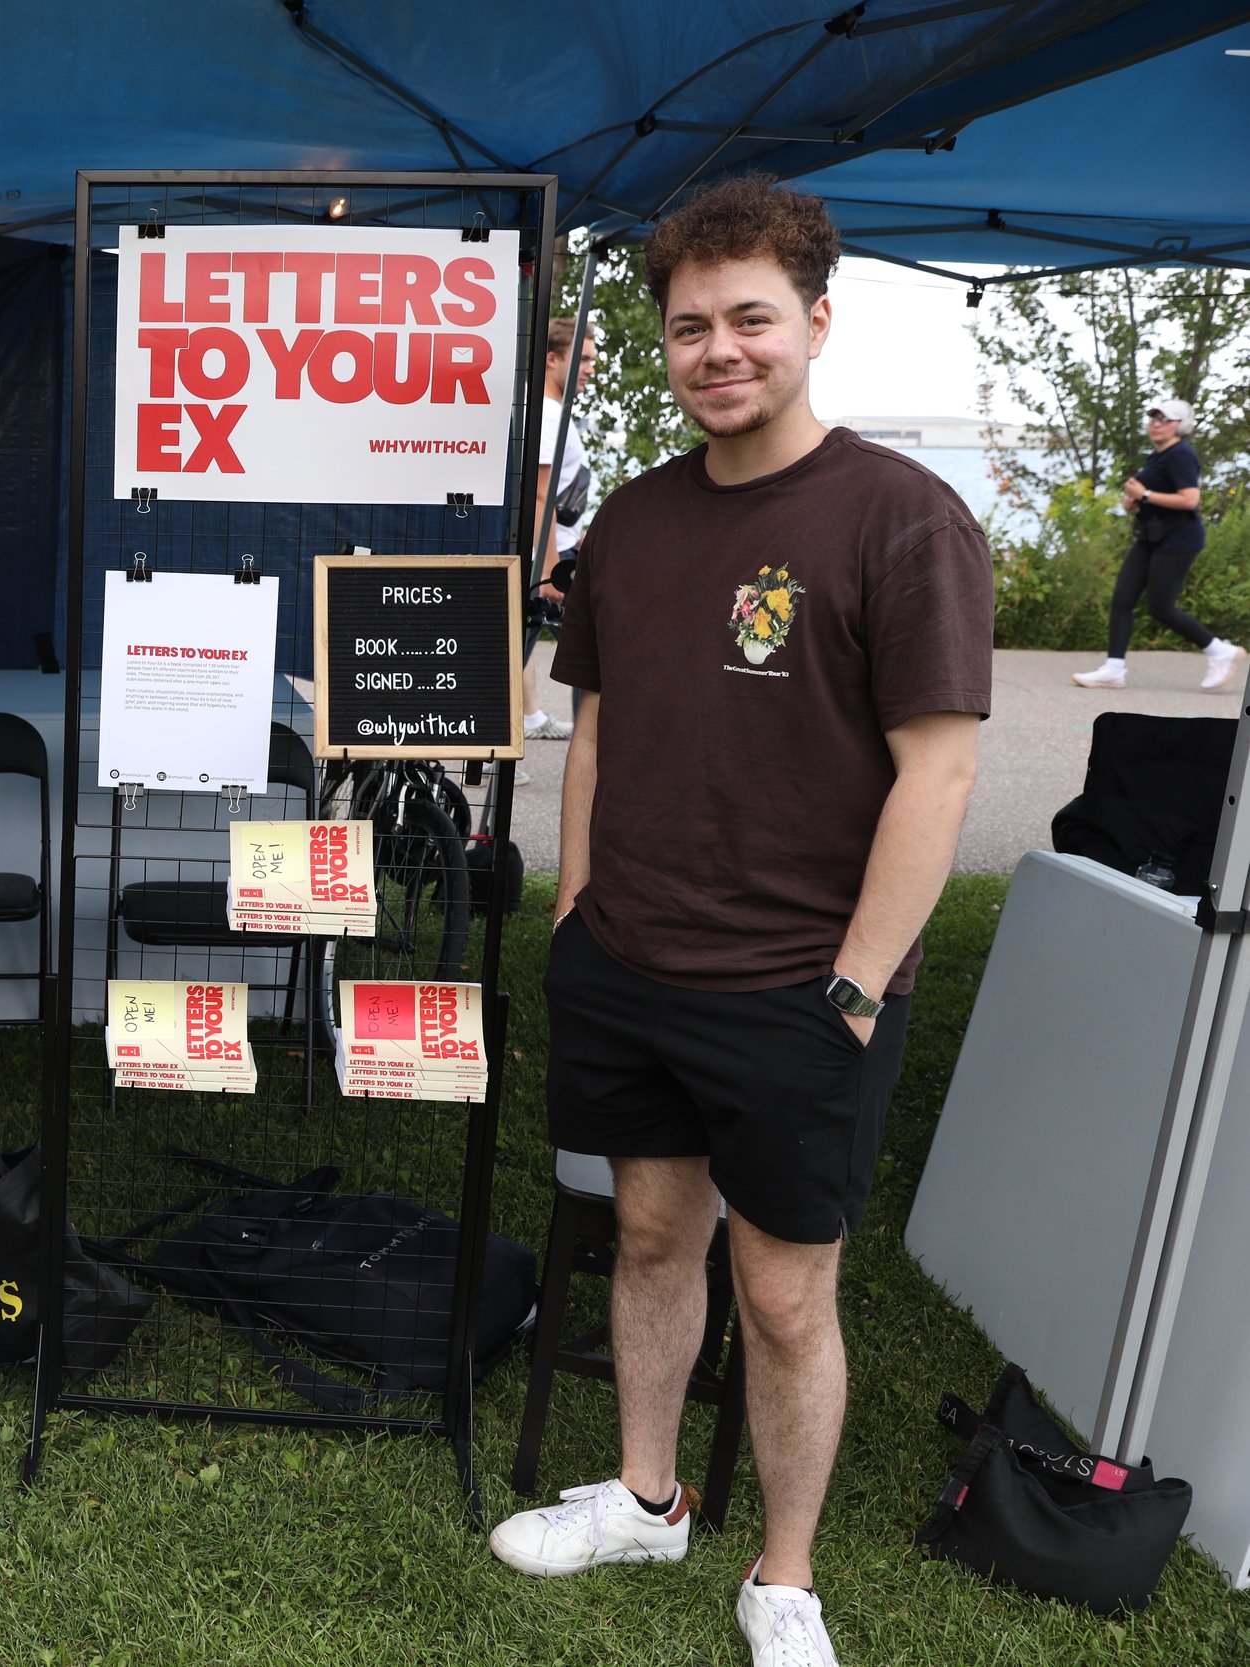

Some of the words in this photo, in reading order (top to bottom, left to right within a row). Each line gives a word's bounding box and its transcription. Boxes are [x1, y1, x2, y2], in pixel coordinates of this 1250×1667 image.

[139, 252, 497, 327] LETTERS
[137, 327, 251, 400] TO
[256, 329, 493, 405] YOUR
[136, 403, 248, 474] EX
[369, 439, 487, 455] WHYWITHCAI
[127, 645, 178, 657] LETTERS
[180, 648, 196, 658] TO
[197, 648, 231, 660] YOUR
[232, 650, 248, 660] EX
[357, 713, 476, 746] @whywithcai
[250, 843, 266, 880] OPEN
[310, 825, 330, 901] LETTERS
[329, 825, 349, 881] YOUR
[275, 902, 292, 910] YOUR
[330, 882, 349, 902] TO
[349, 884, 369, 903] EX
[125, 995, 137, 1033] OPEN
[186, 985, 205, 1060] LETTERS
[205, 986, 223, 1038] YOUR
[368, 996, 380, 1033] OPEN
[419, 985, 440, 1059] LETTERS
[439, 986, 457, 1038] YOUR
[205, 1039, 223, 1060] TO
[224, 1040, 242, 1061] EX
[440, 1039, 459, 1059] TO
[459, 1040, 479, 1061] EX
